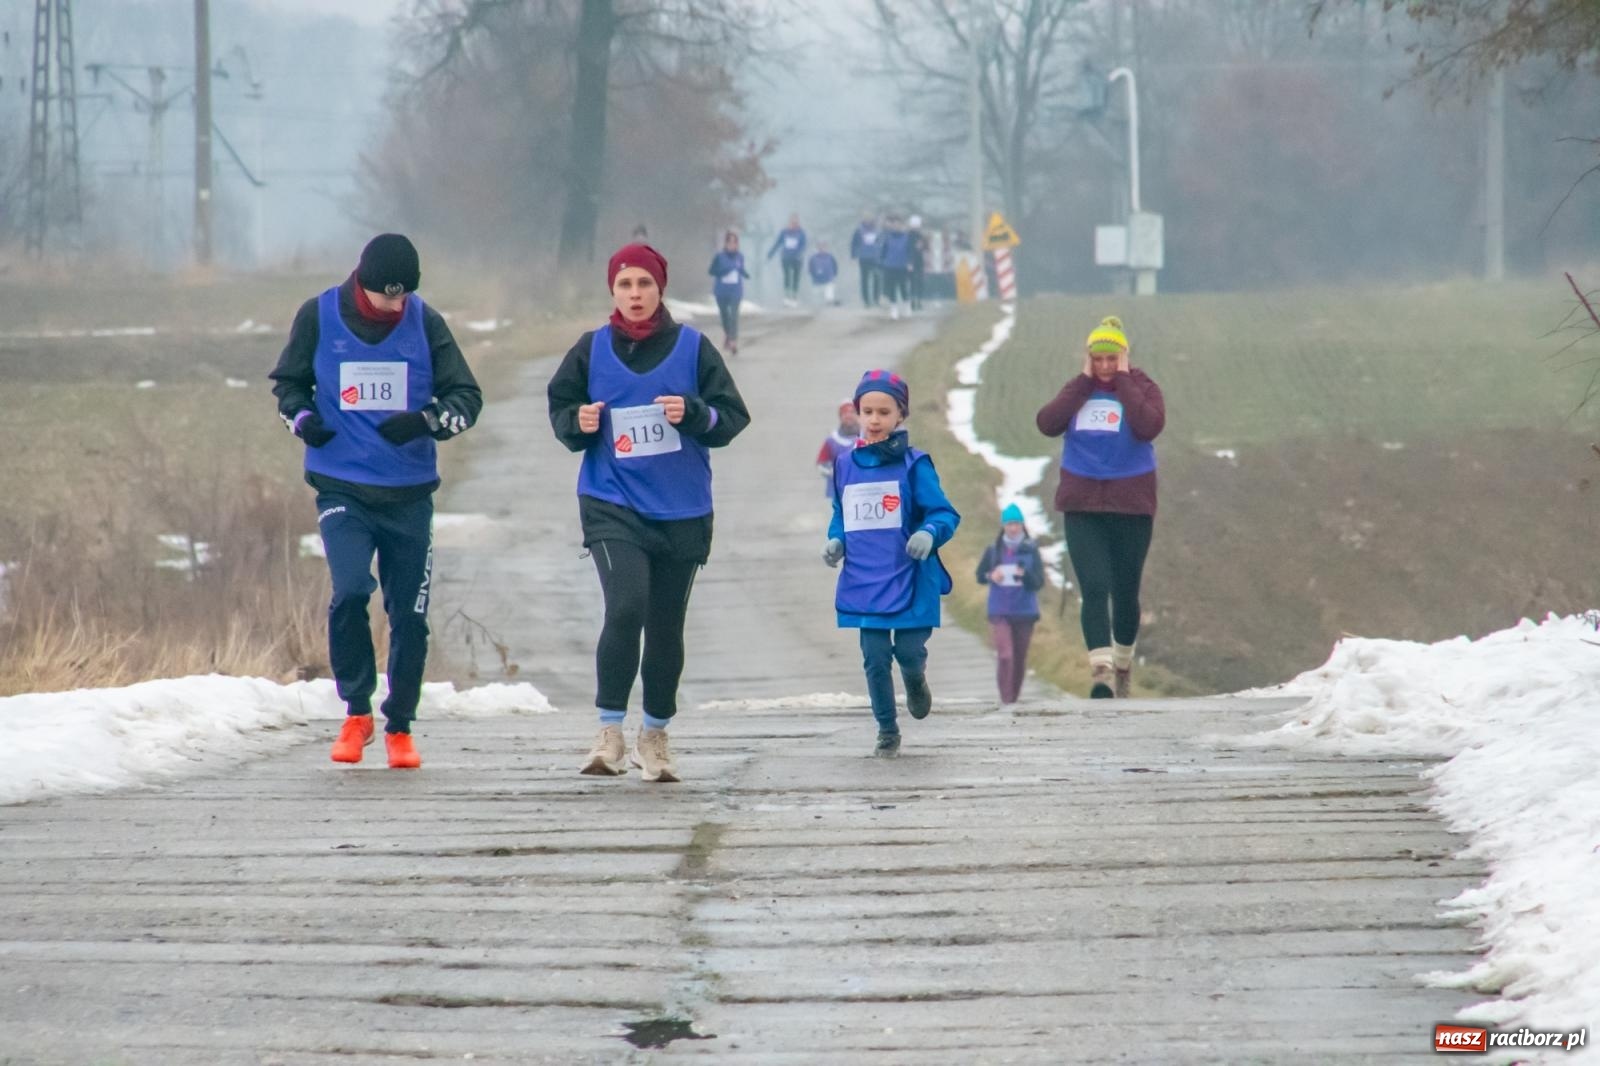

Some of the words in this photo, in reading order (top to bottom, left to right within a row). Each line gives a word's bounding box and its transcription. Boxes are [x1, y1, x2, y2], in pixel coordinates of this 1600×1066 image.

[359, 382, 392, 400] 118
[629, 423, 664, 444] 119
[854, 502, 886, 520] 120
